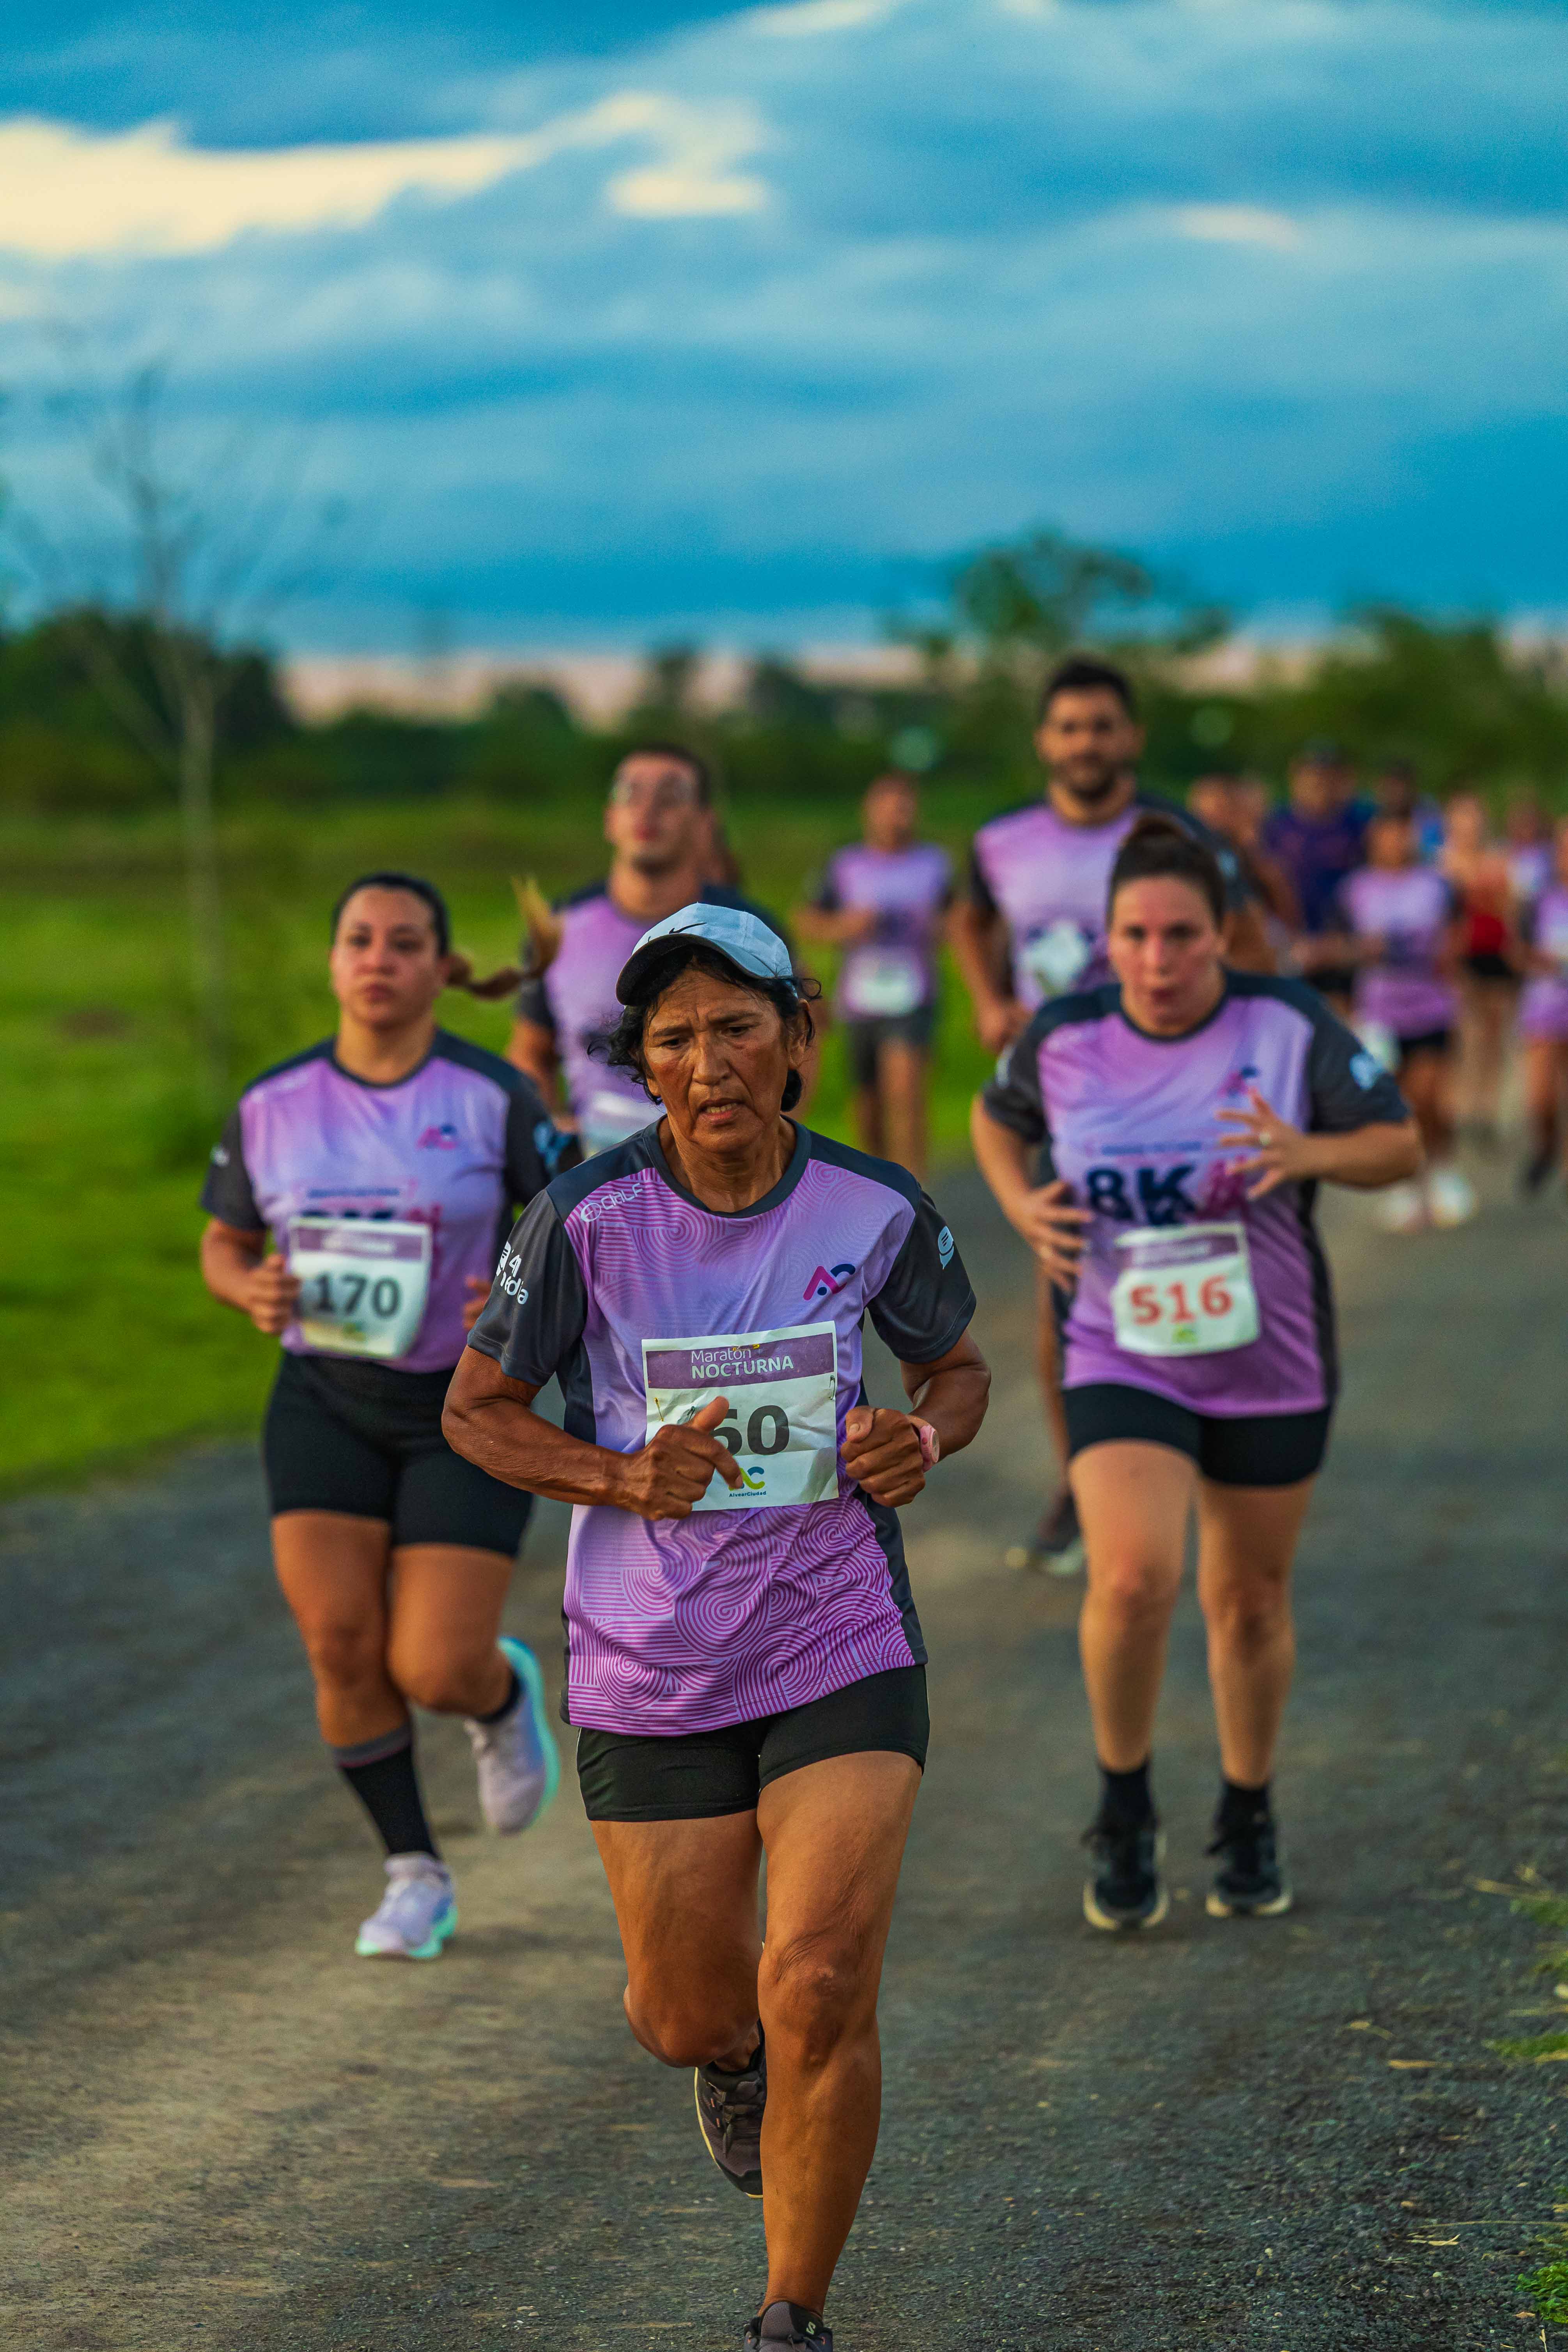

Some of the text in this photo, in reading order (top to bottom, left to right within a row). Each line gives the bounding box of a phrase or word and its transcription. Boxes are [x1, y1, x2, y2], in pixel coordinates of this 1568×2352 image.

[314, 1271, 401, 1318] 170
[1130, 1273, 1233, 1326] 516
[692, 1355, 794, 1379] NOCTURNA
